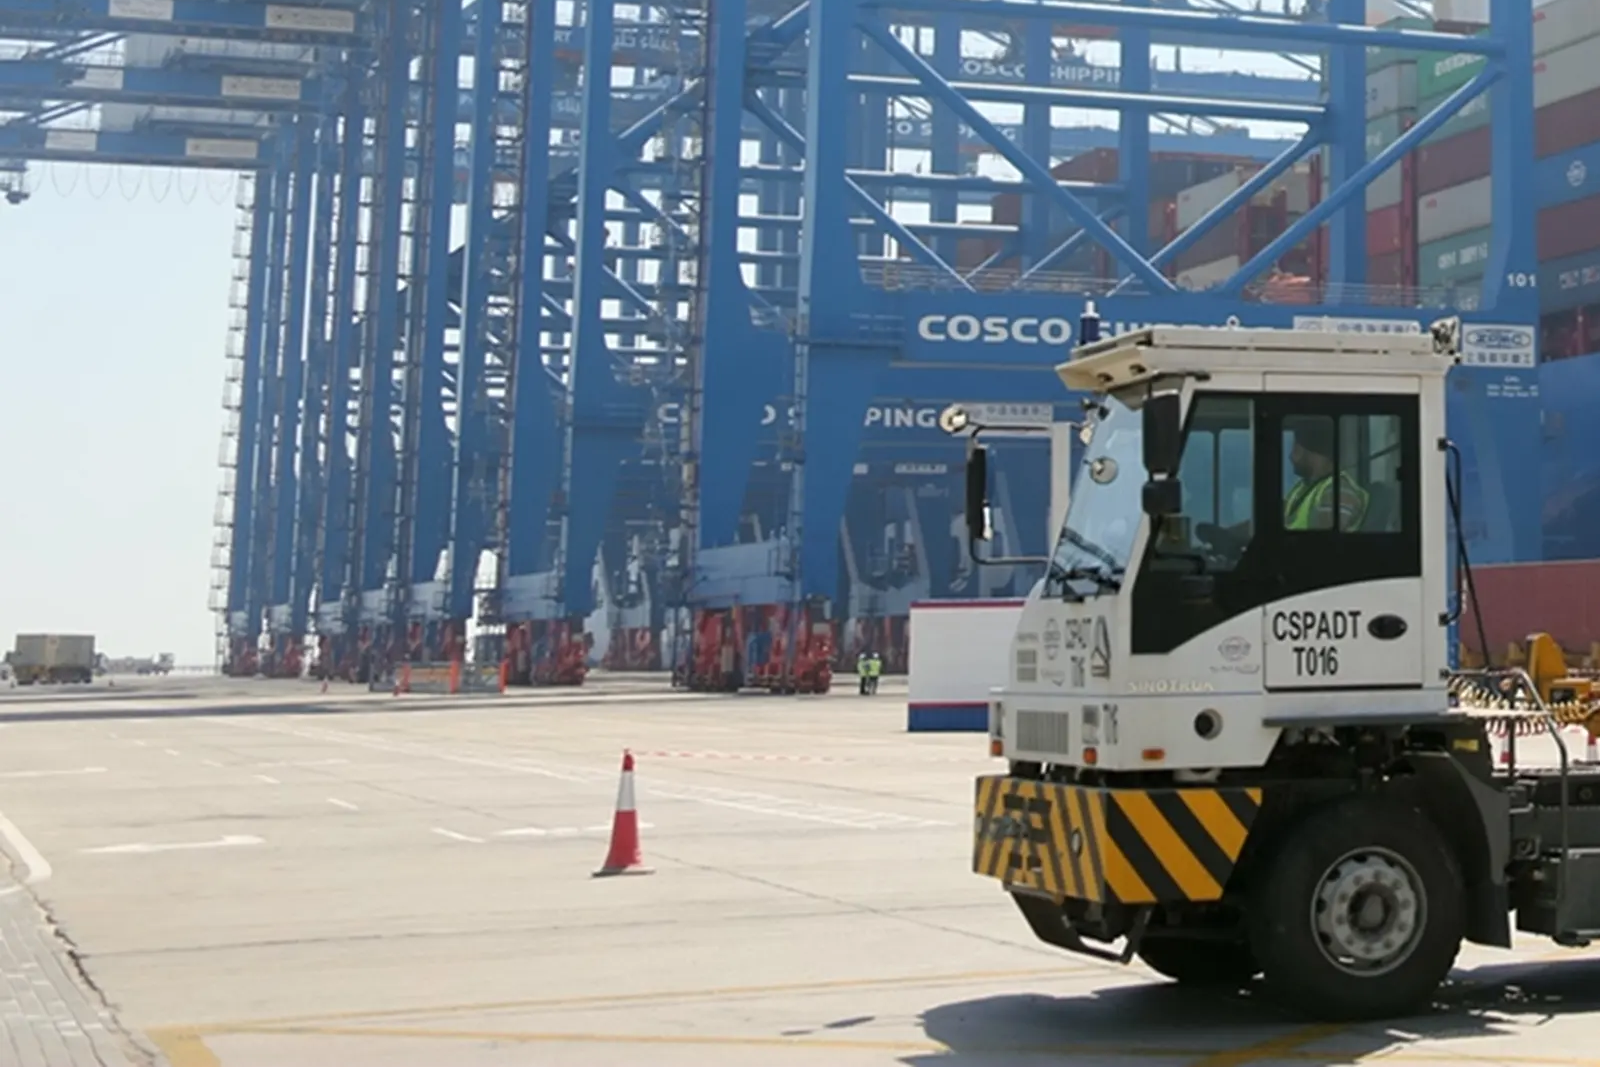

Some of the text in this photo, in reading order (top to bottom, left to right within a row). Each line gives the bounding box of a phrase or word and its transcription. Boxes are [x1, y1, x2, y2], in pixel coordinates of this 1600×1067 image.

[1507, 272, 1536, 287] 101
[918, 314, 1072, 344] COSCO
[1273, 610, 1362, 641] CSPADT
[1293, 646, 1339, 676] T016
